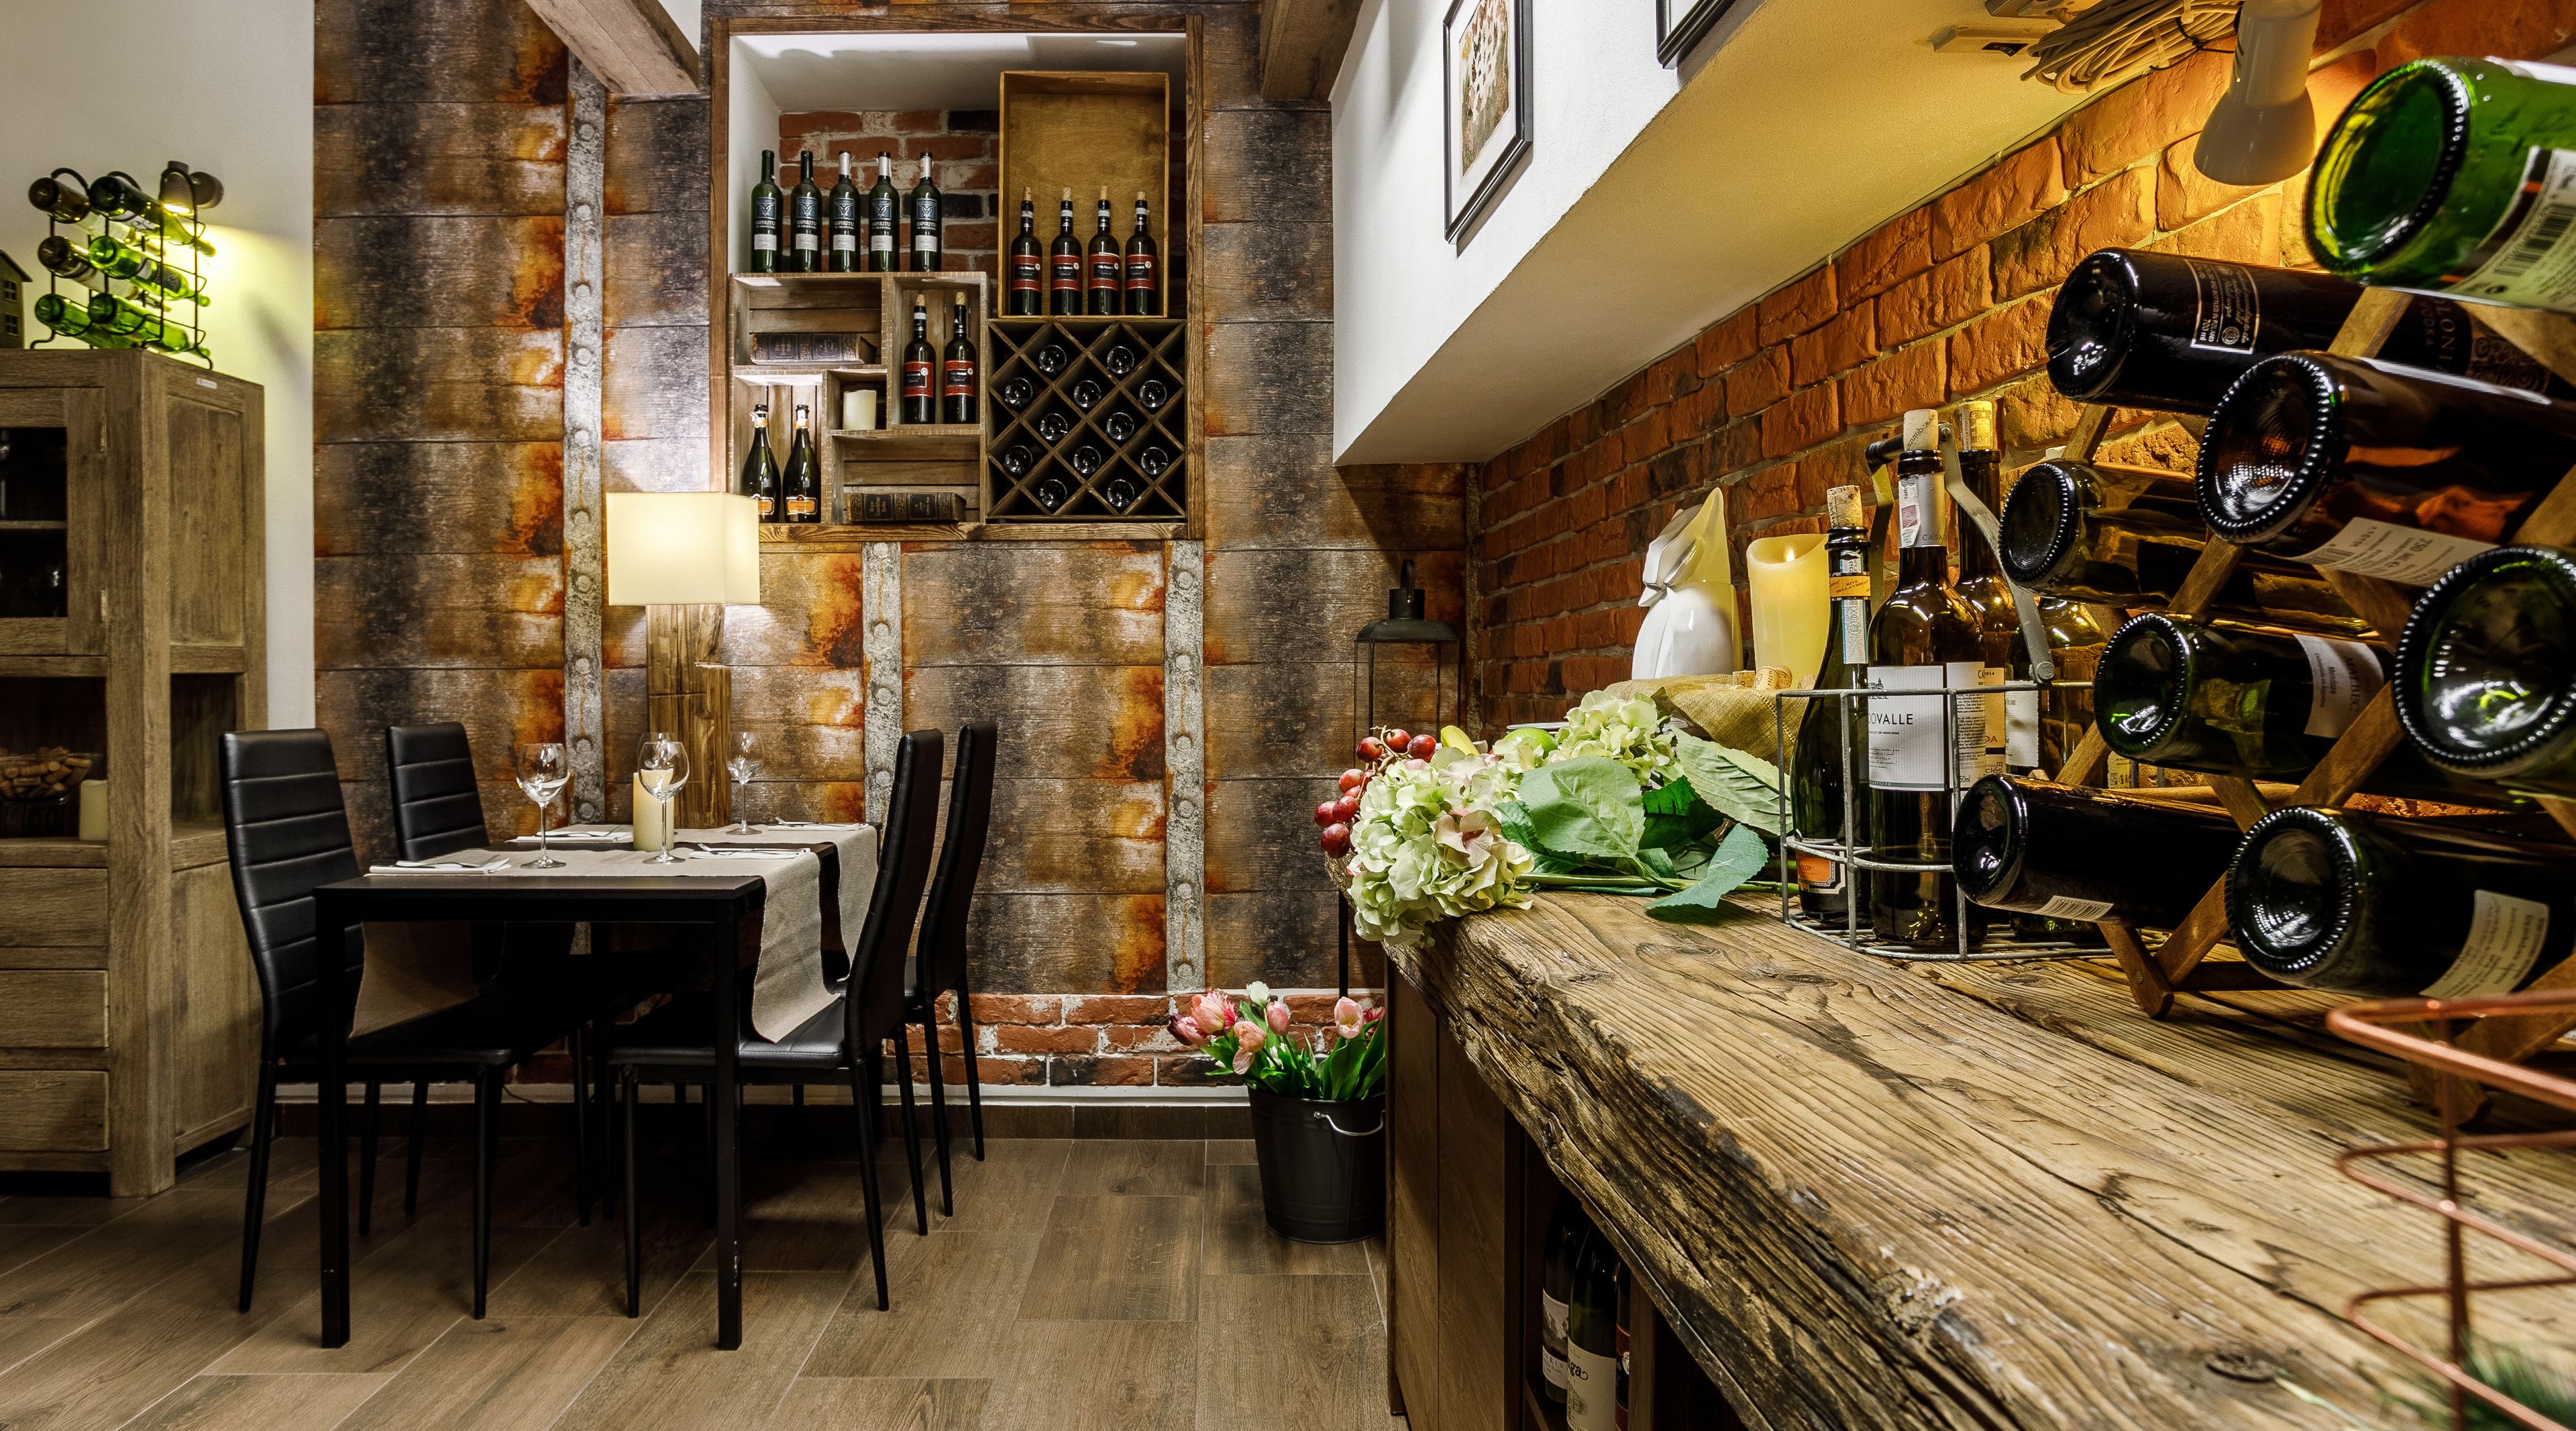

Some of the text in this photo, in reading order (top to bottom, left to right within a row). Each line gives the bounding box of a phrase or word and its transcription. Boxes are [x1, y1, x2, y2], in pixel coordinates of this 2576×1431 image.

[2200, 319, 2210, 341] 700 ml
[2208, 319, 2218, 342] POLAND
[2327, 666, 2338, 694] Mendoza
[2344, 655, 2361, 712] MALBEC
[1960, 775, 1971, 783] 50ml
